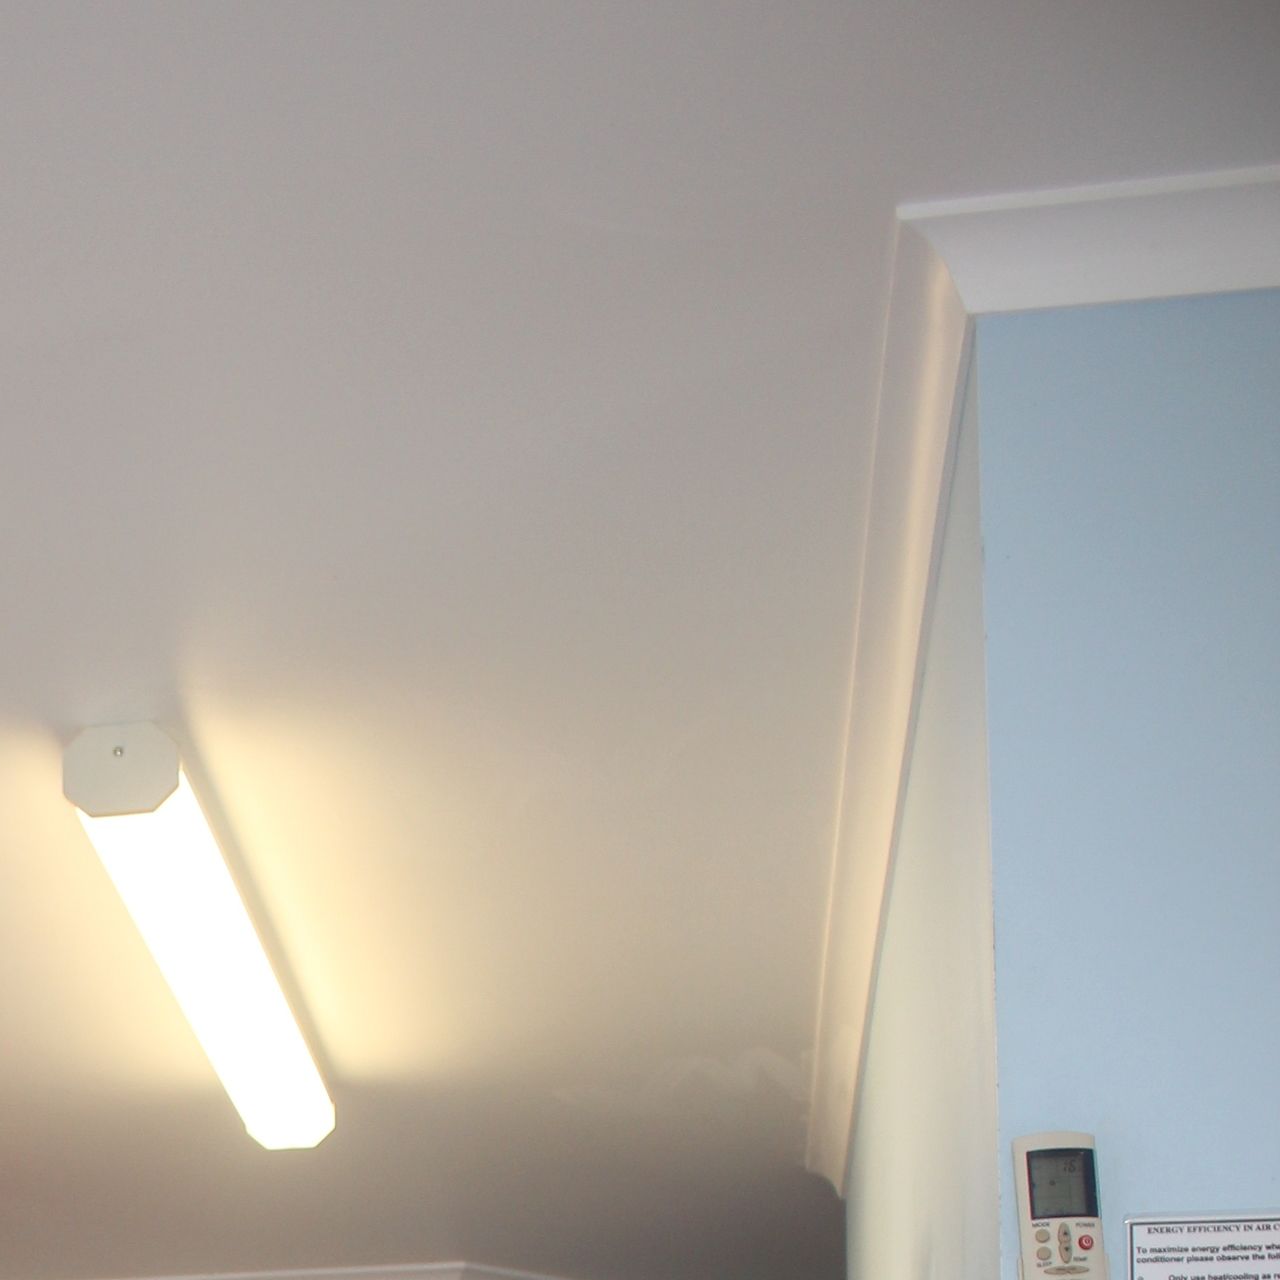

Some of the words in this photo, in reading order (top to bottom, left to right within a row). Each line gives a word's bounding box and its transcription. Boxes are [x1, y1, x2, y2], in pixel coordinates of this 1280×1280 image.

[1147, 1226, 1184, 1234] ENERGY
[1186, 1224, 1240, 1233] EFFICIENCY
[1255, 1223, 1271, 1231] AIR
[1136, 1246, 1147, 1254] To
[1191, 1245, 1220, 1253] energy
[1222, 1243, 1262, 1252] efficiency
[1136, 1255, 1184, 1264] conditioner
[1186, 1254, 1214, 1263] please
[1216, 1253, 1250, 1261] observe
